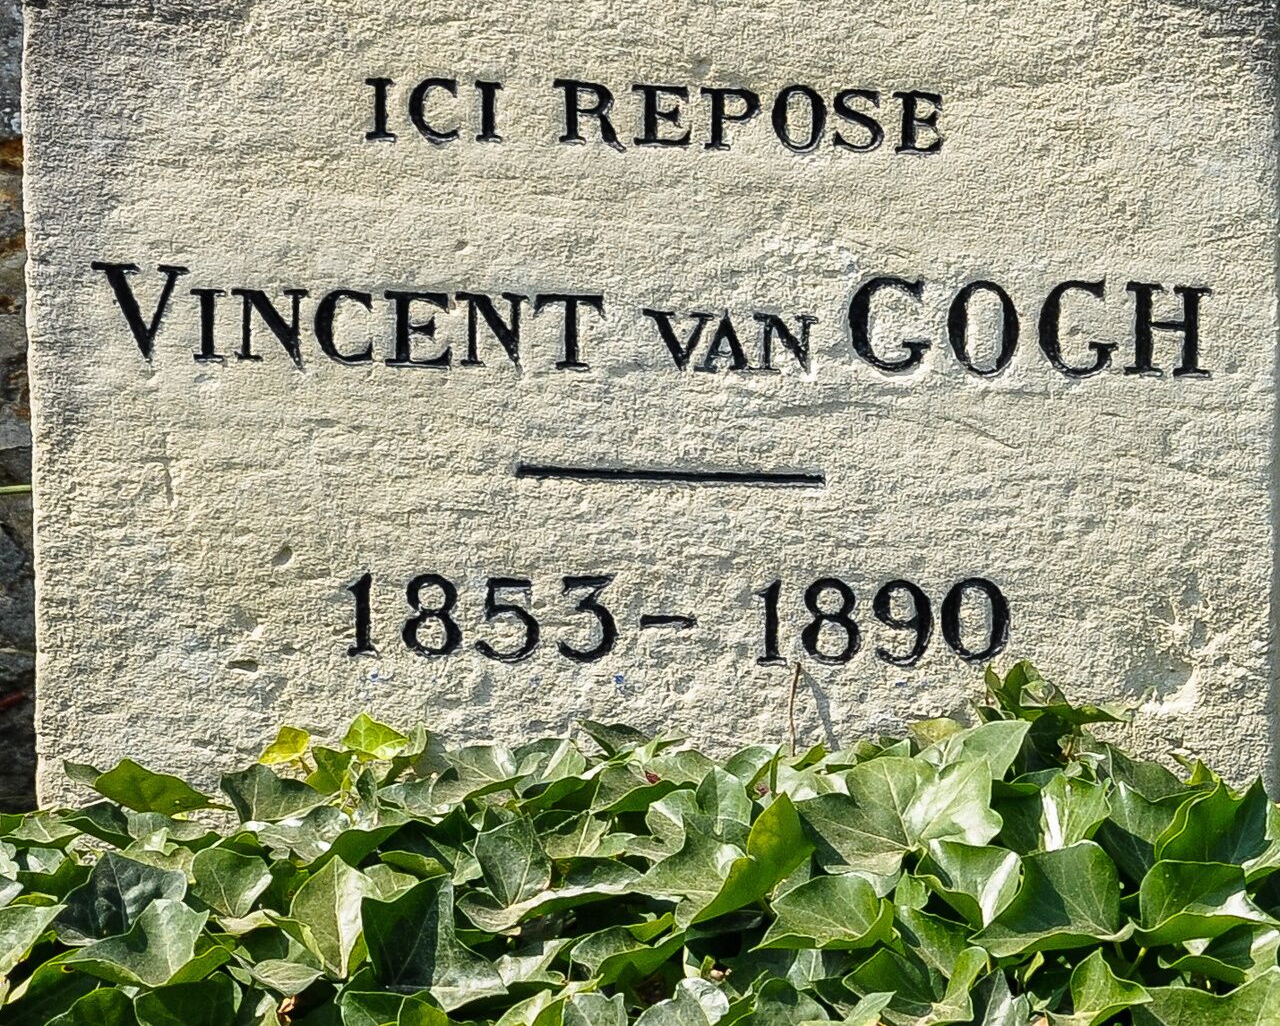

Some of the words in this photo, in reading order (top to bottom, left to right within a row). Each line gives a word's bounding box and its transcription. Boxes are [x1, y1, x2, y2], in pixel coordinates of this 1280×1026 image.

[365, 77, 502, 143] ICI
[553, 79, 944, 152] REPOSE
[91, 262, 603, 370] VINCENT
[643, 308, 818, 373] VAN
[848, 277, 1212, 377] GOGH
